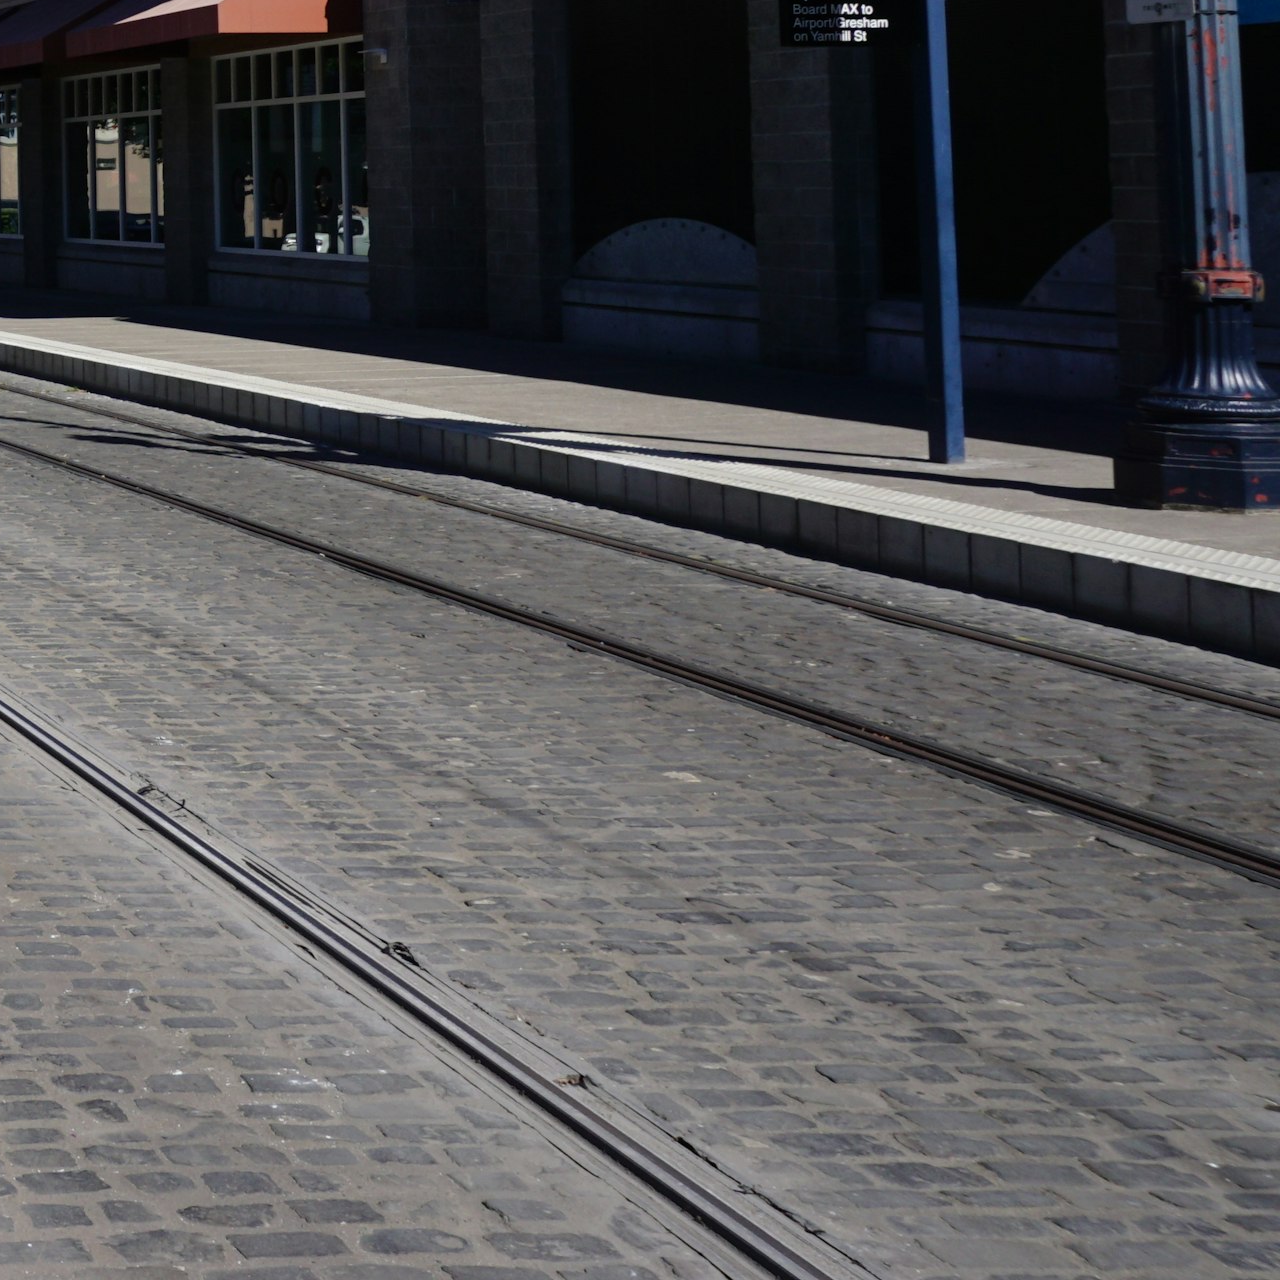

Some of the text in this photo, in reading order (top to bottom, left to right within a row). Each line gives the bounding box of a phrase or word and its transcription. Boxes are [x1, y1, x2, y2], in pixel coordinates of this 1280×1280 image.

[792, 3, 874, 15] Board MAX to
[793, 16, 889, 30] Airport/Gresham
[793, 30, 867, 42] on Yamhill St
